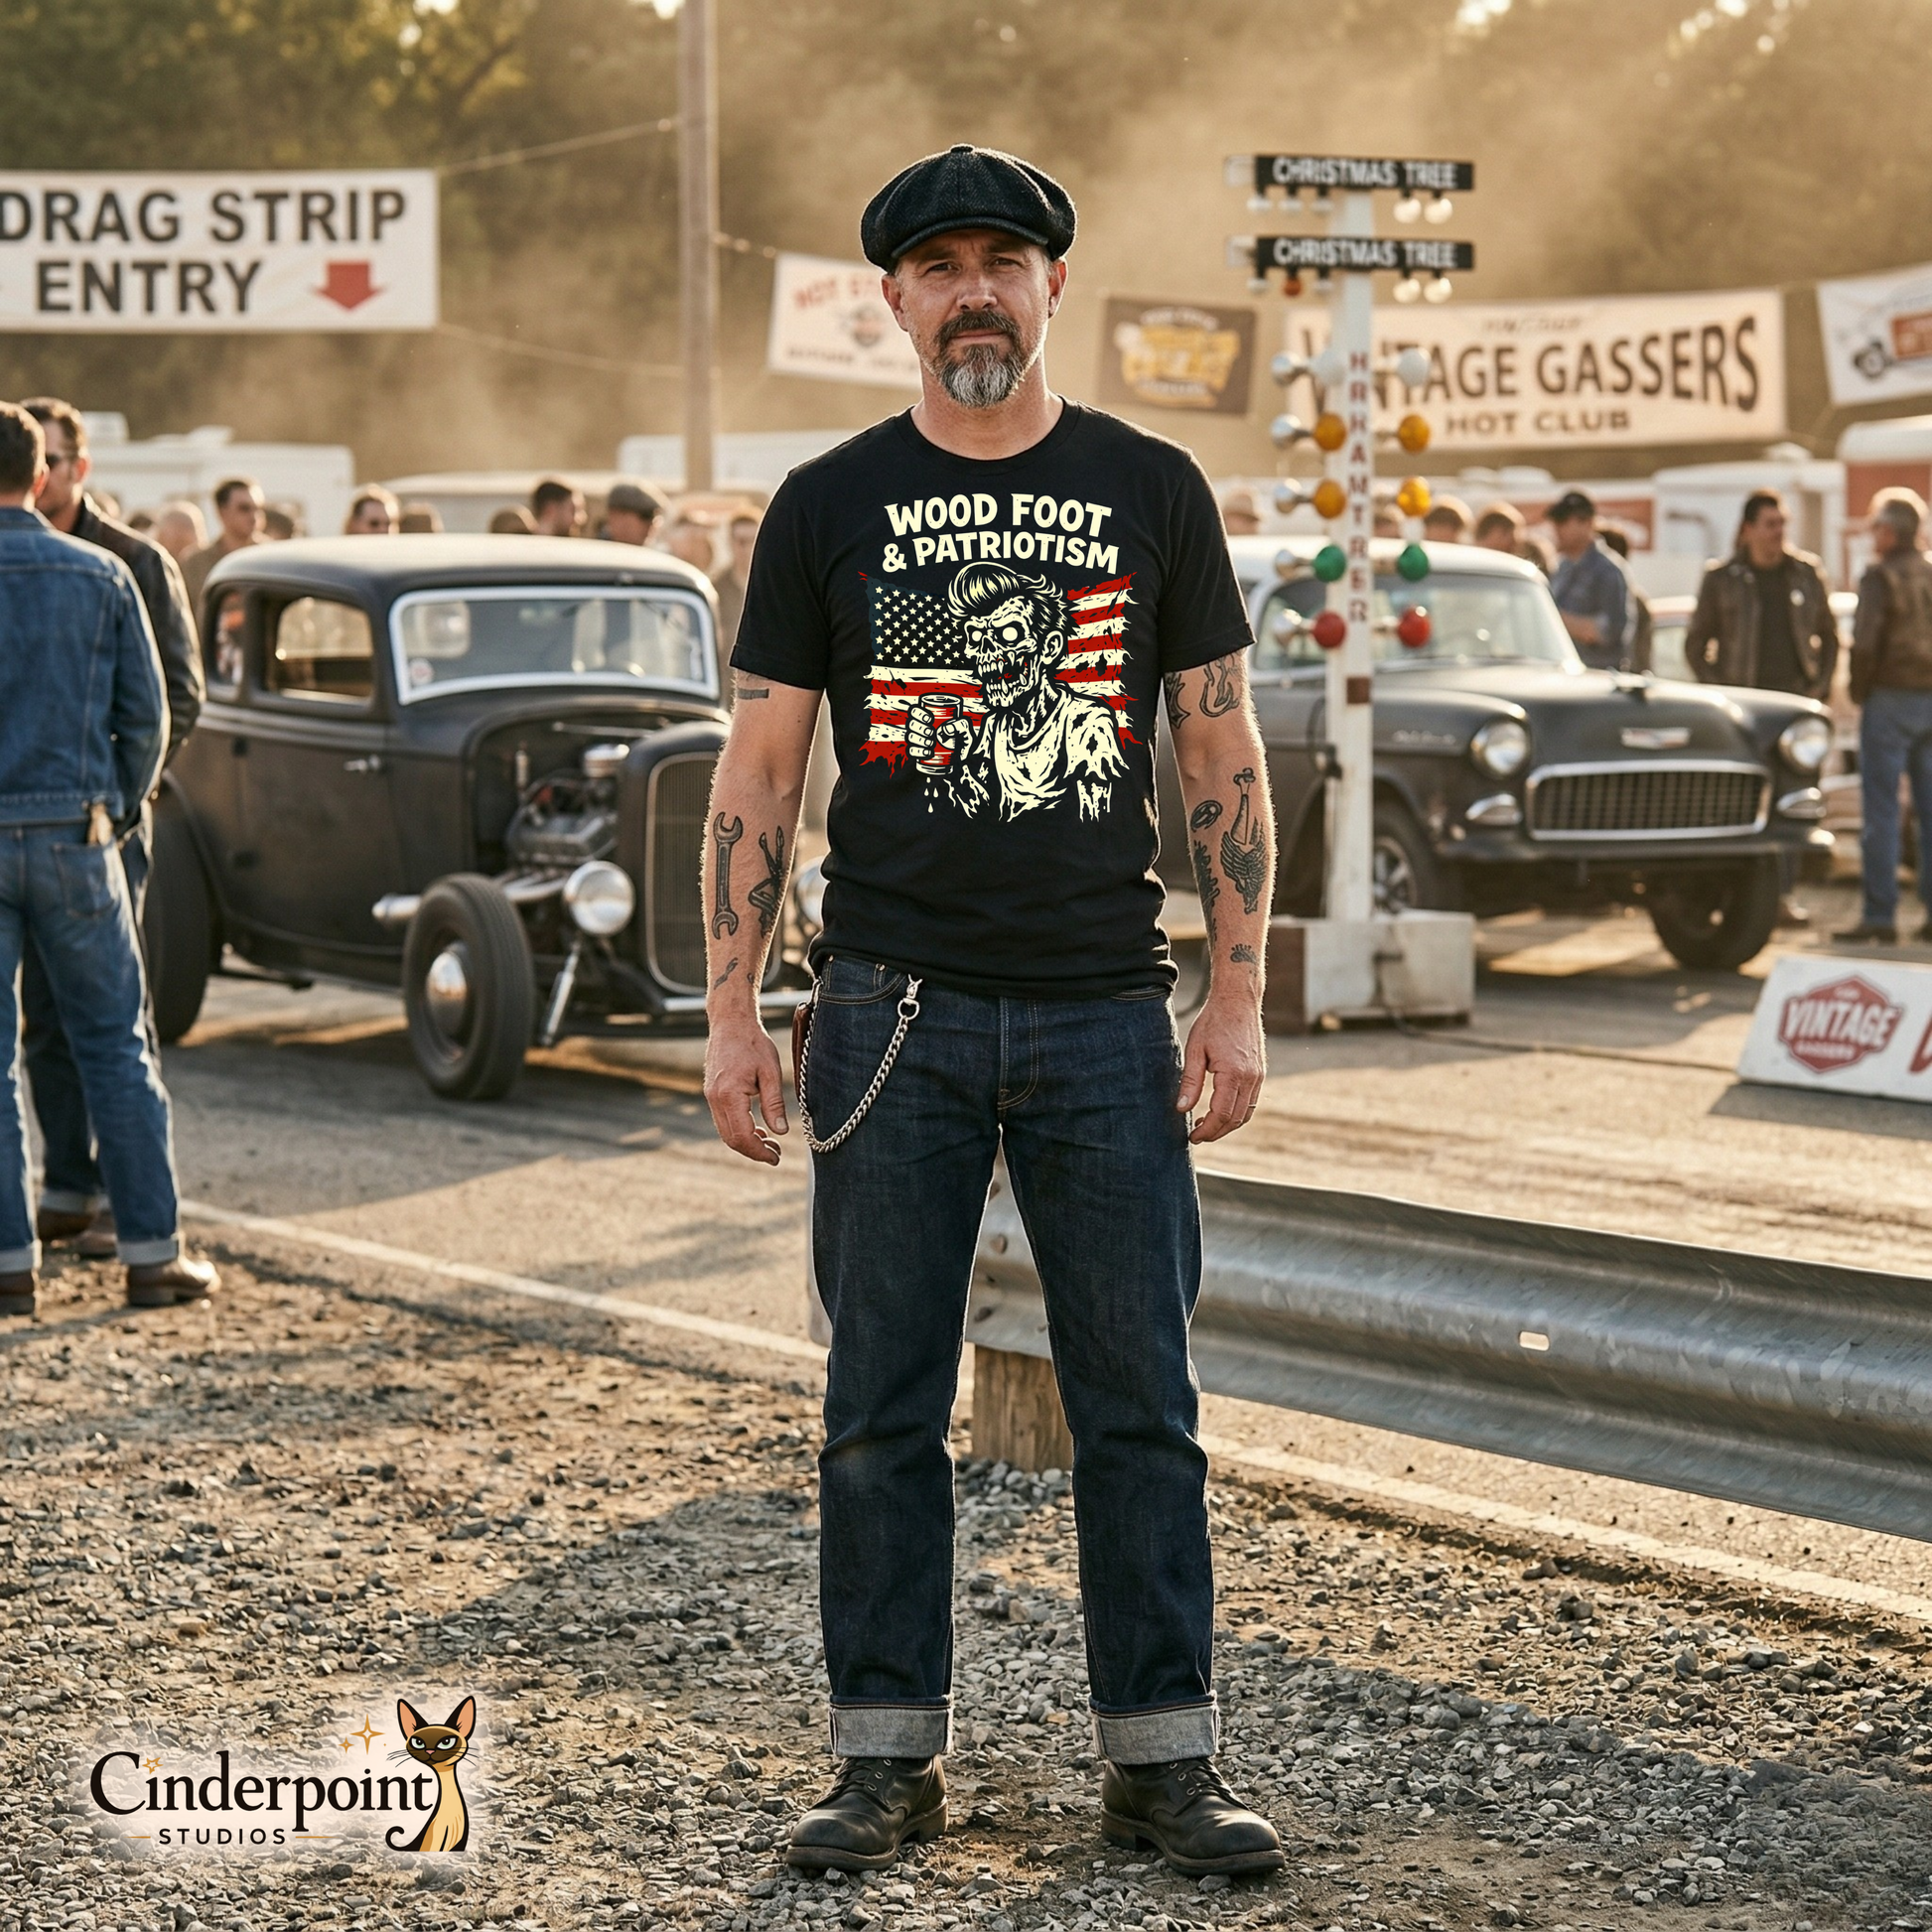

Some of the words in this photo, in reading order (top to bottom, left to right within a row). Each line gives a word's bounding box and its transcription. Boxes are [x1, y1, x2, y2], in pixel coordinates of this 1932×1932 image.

[1272, 157, 1398, 187] CHRISTMAS
[1403, 162, 1458, 189] TREE
[0, 190, 182, 244] DRAG
[209, 190, 406, 244] STRIP
[1272, 237, 1398, 268] CHRISTMAS
[1404, 241, 1458, 268] TREE
[36, 259, 262, 314] ENTRY
[1535, 316, 1760, 412] GASSERS
[1446, 411, 1517, 437] HOT
[1534, 409, 1632, 434] CLUB
[884, 492, 998, 537] WOOD
[1011, 492, 1113, 538] FOOT
[882, 542, 907, 573] &
[911, 530, 1120, 575] PATRIOTISM
[1784, 997, 1899, 1048] VINTAGE
